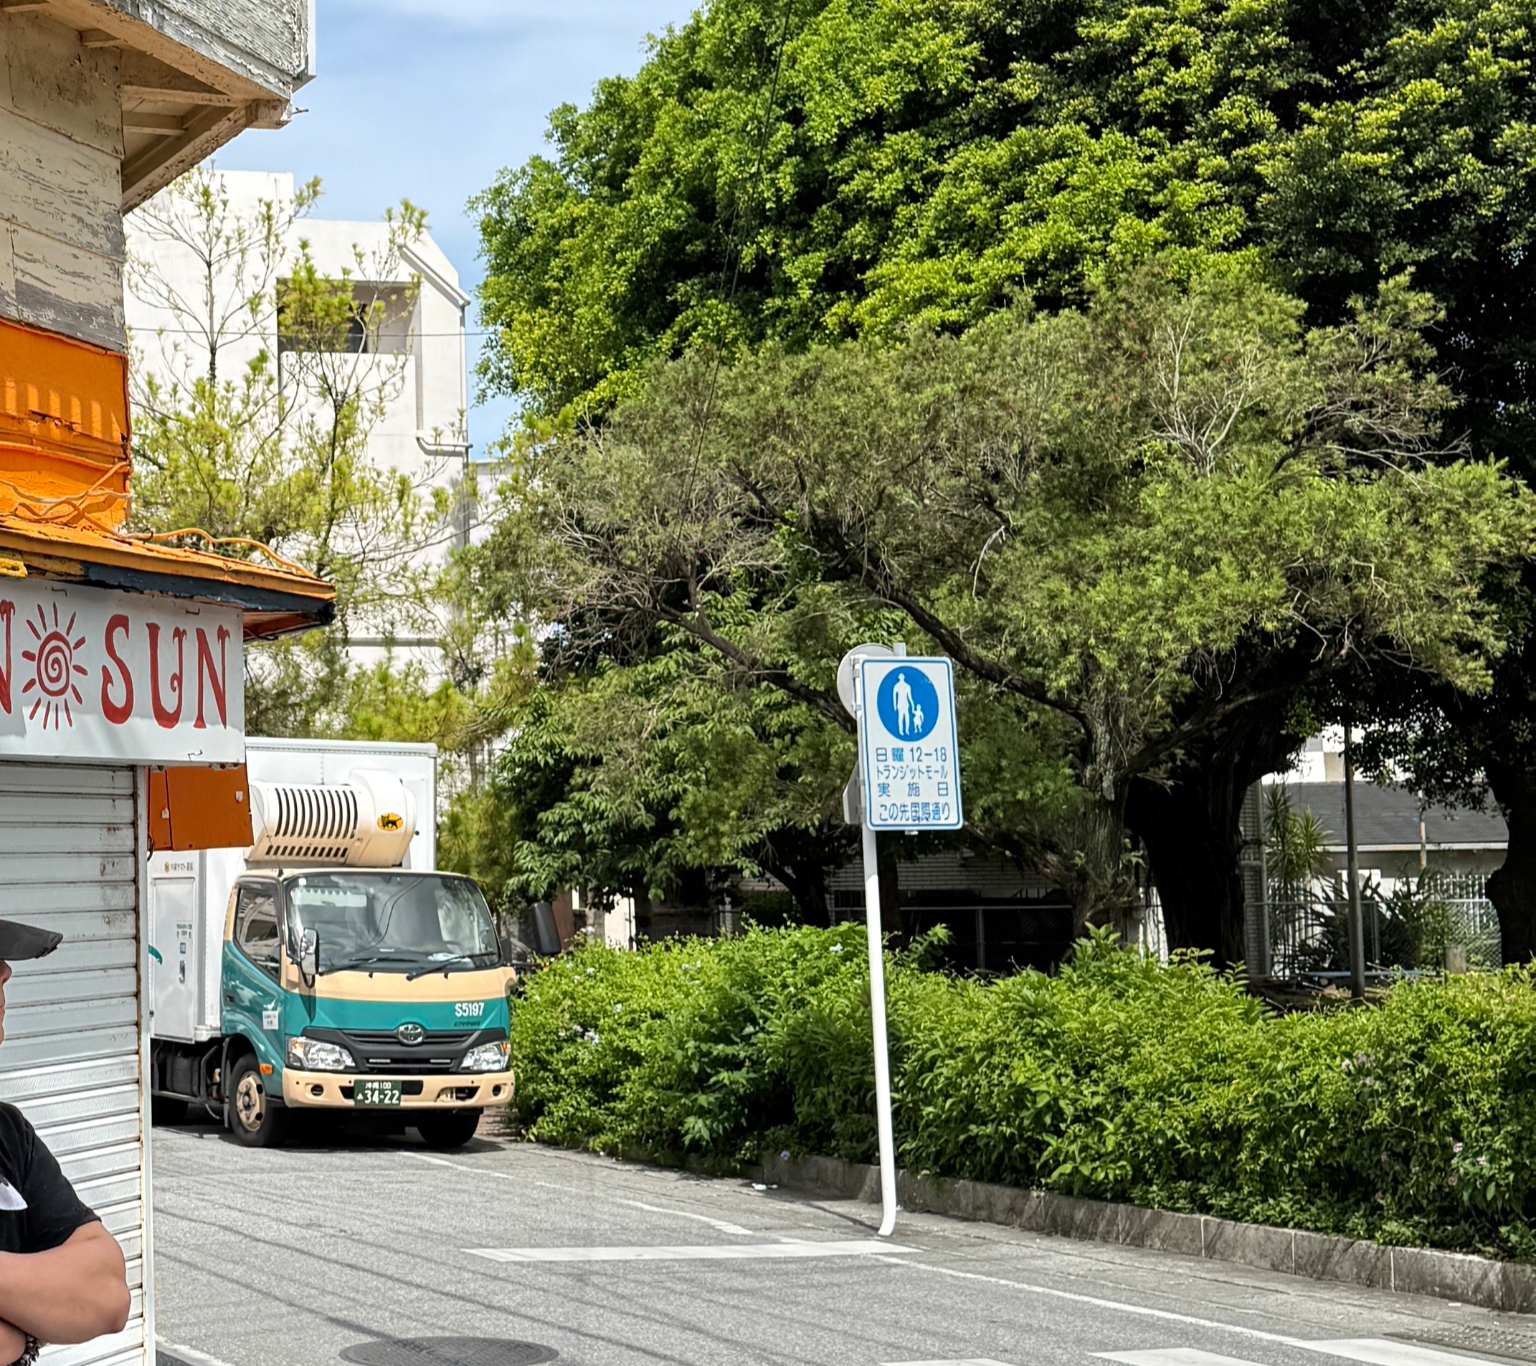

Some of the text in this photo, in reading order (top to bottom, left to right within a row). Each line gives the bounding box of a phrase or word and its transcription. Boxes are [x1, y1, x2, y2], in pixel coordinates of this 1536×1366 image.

[101, 613, 231, 729] SUN
[876, 764, 948, 780] トランジットモール
[454, 1002, 485, 1017] S5197
[364, 1089, 400, 1104] 34-22
